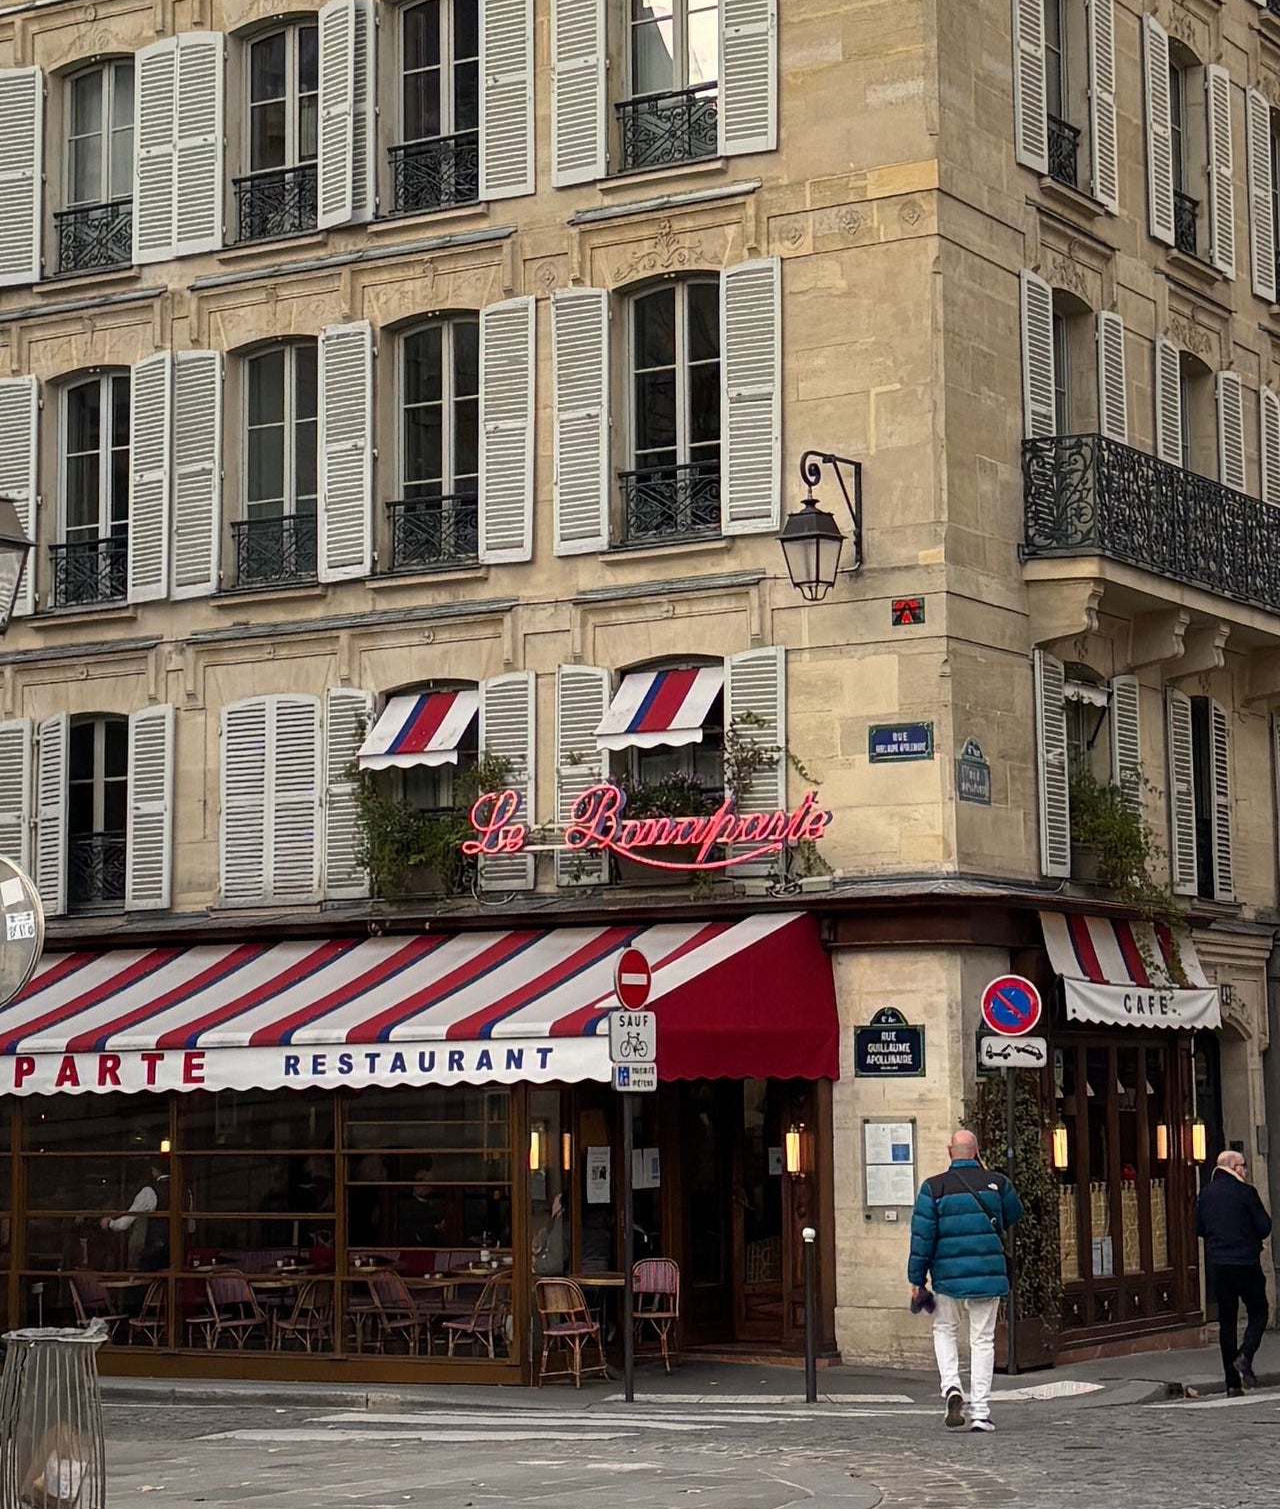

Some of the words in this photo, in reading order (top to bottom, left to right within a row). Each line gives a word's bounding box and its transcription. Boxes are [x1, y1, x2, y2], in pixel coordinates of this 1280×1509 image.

[462, 790, 527, 855] Le
[565, 781, 833, 869] Bonaparte
[619, 1015, 648, 1027] SAUF
[881, 1032, 896, 1041] RUE
[867, 1043, 910, 1052] GUILLAUME
[284, 1047, 553, 1075] RESTAURANT
